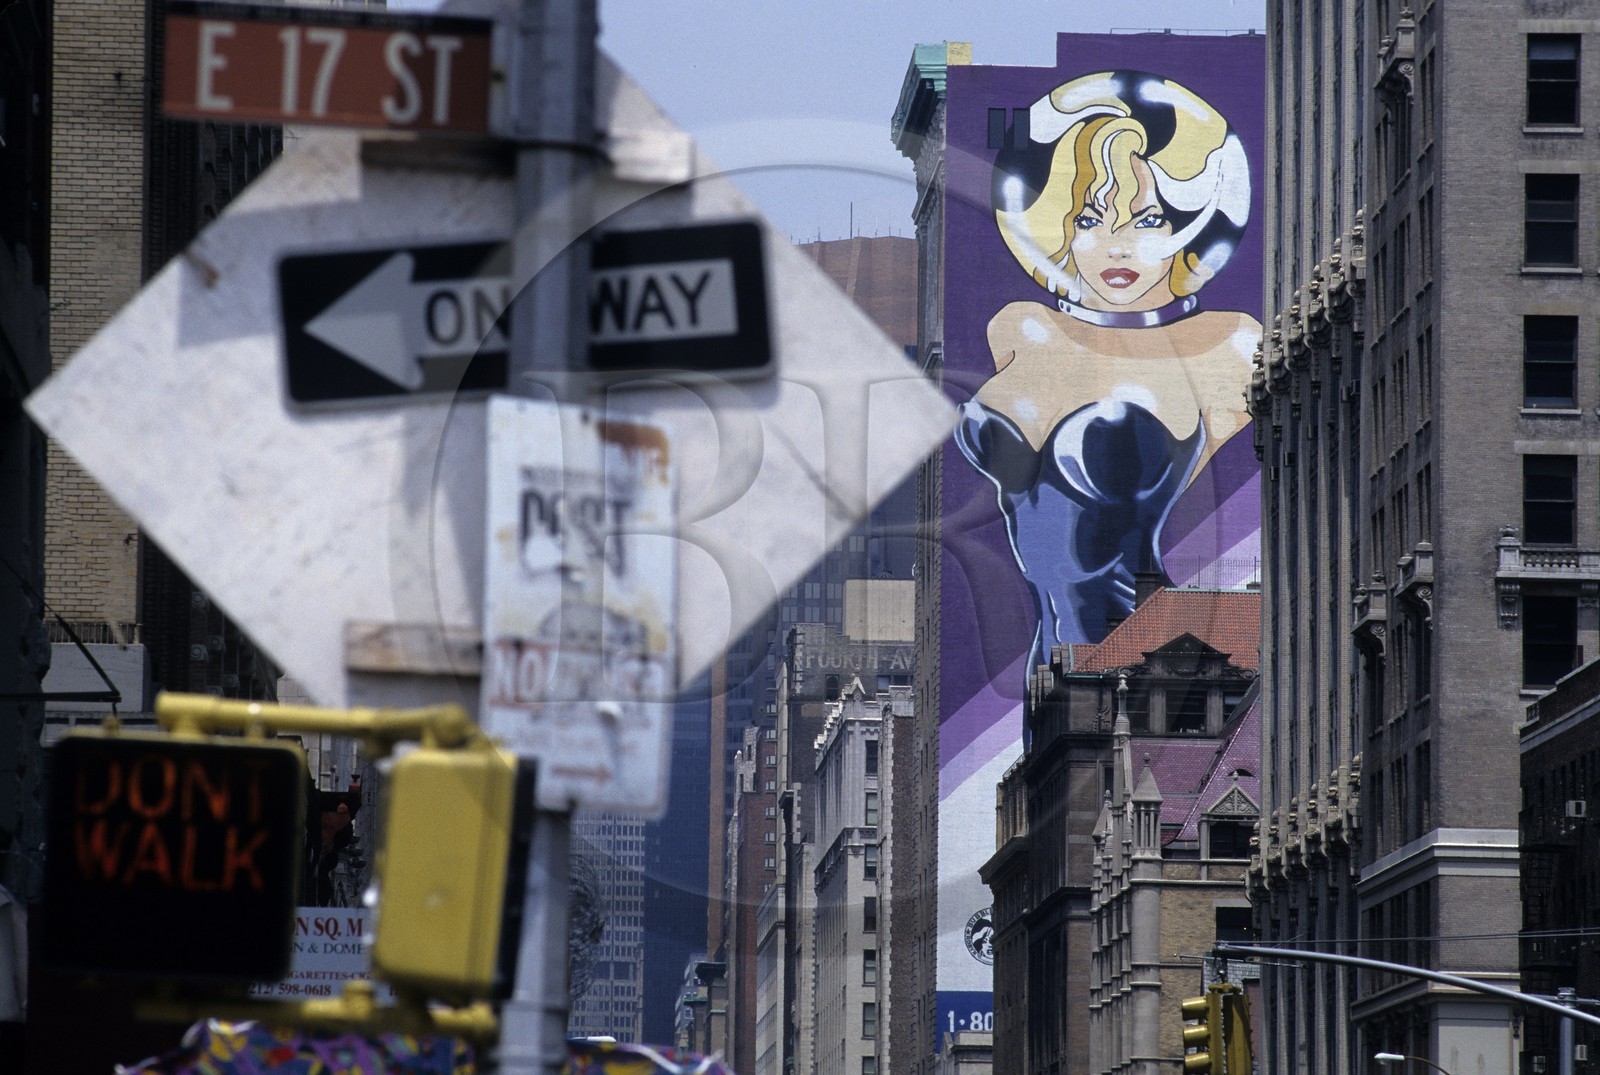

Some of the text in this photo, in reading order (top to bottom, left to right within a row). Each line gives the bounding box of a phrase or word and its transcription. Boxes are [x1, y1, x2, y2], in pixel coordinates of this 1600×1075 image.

[196, 20, 463, 125] E 17 ST
[423, 270, 711, 347] ON WAY
[74, 818, 269, 892] WALK
[278, 983, 332, 996] 598-0618
